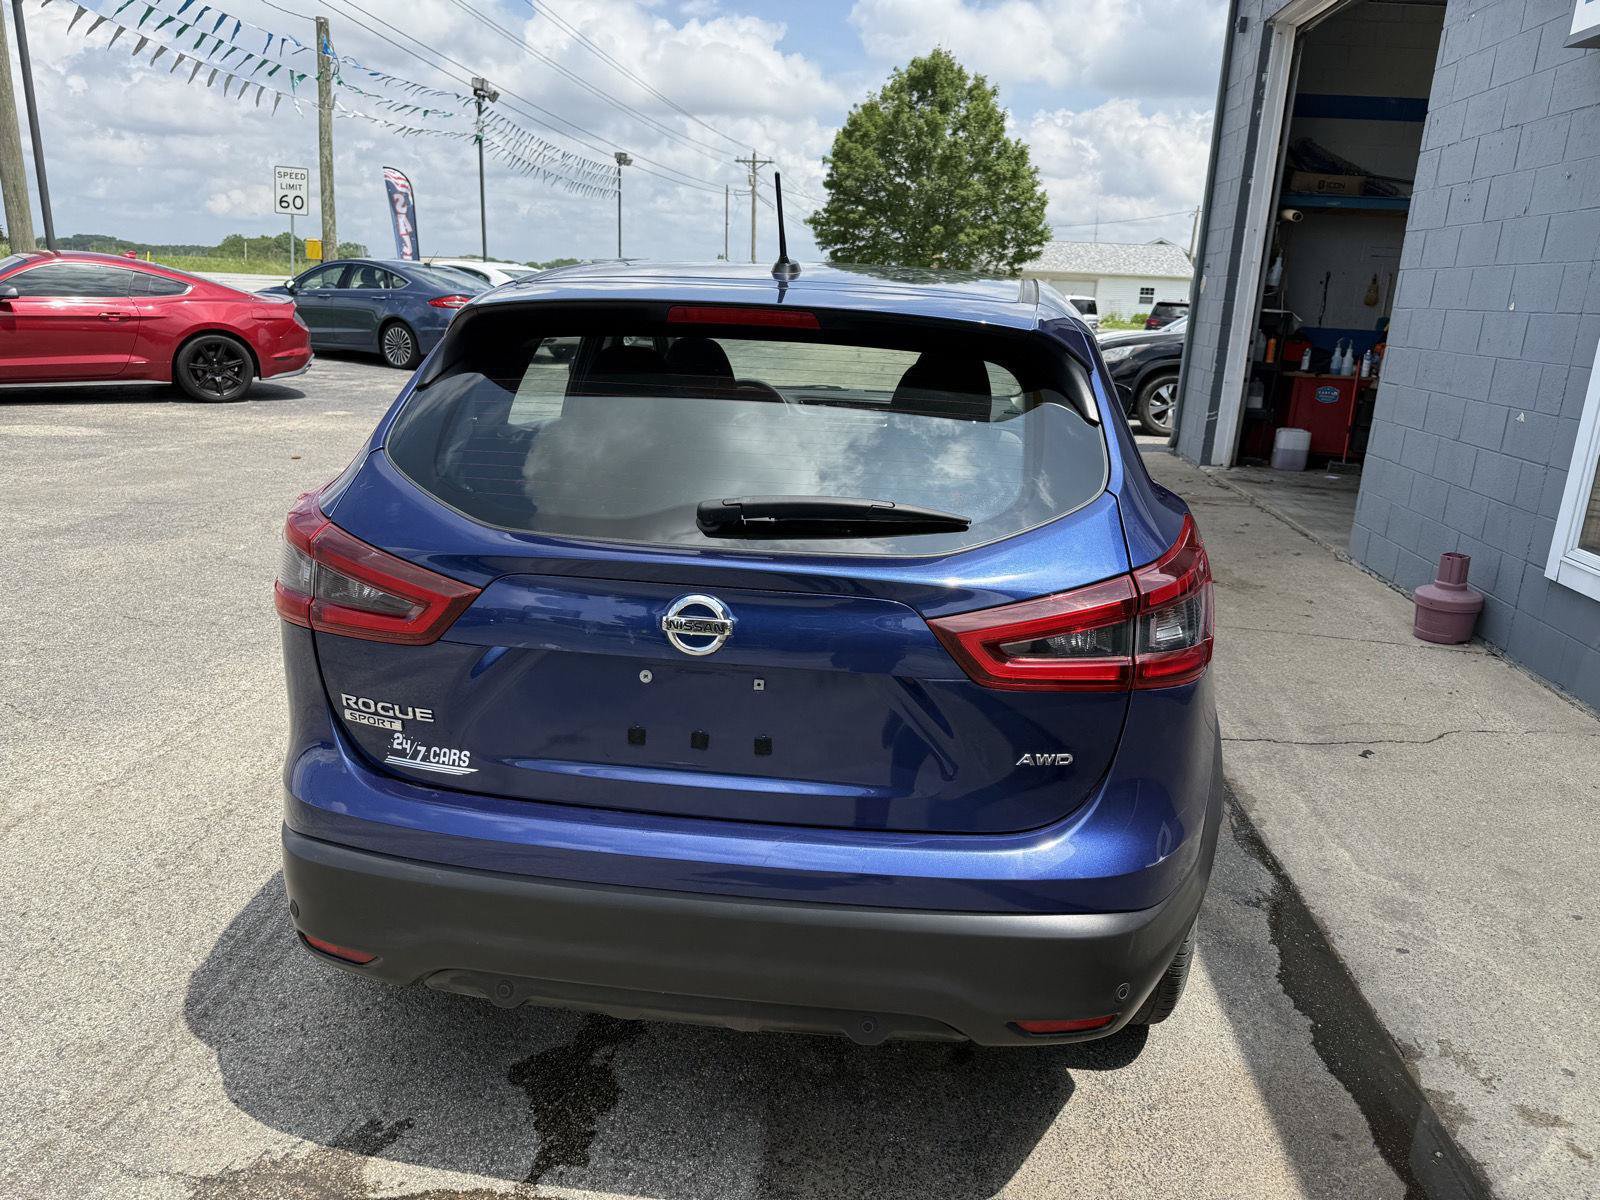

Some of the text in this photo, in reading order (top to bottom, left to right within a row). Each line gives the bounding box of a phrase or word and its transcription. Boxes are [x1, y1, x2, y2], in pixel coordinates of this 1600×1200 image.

[277, 171, 306, 181] SPEED
[280, 183, 303, 191] LIMIT
[279, 194, 304, 210] 60
[667, 619, 726, 635] NISSAN
[341, 693, 434, 722] ROGUE
[349, 711, 396, 729] SPORT
[393, 732, 471, 767] 24/7 CARS
[1015, 753, 1074, 766] AWD
